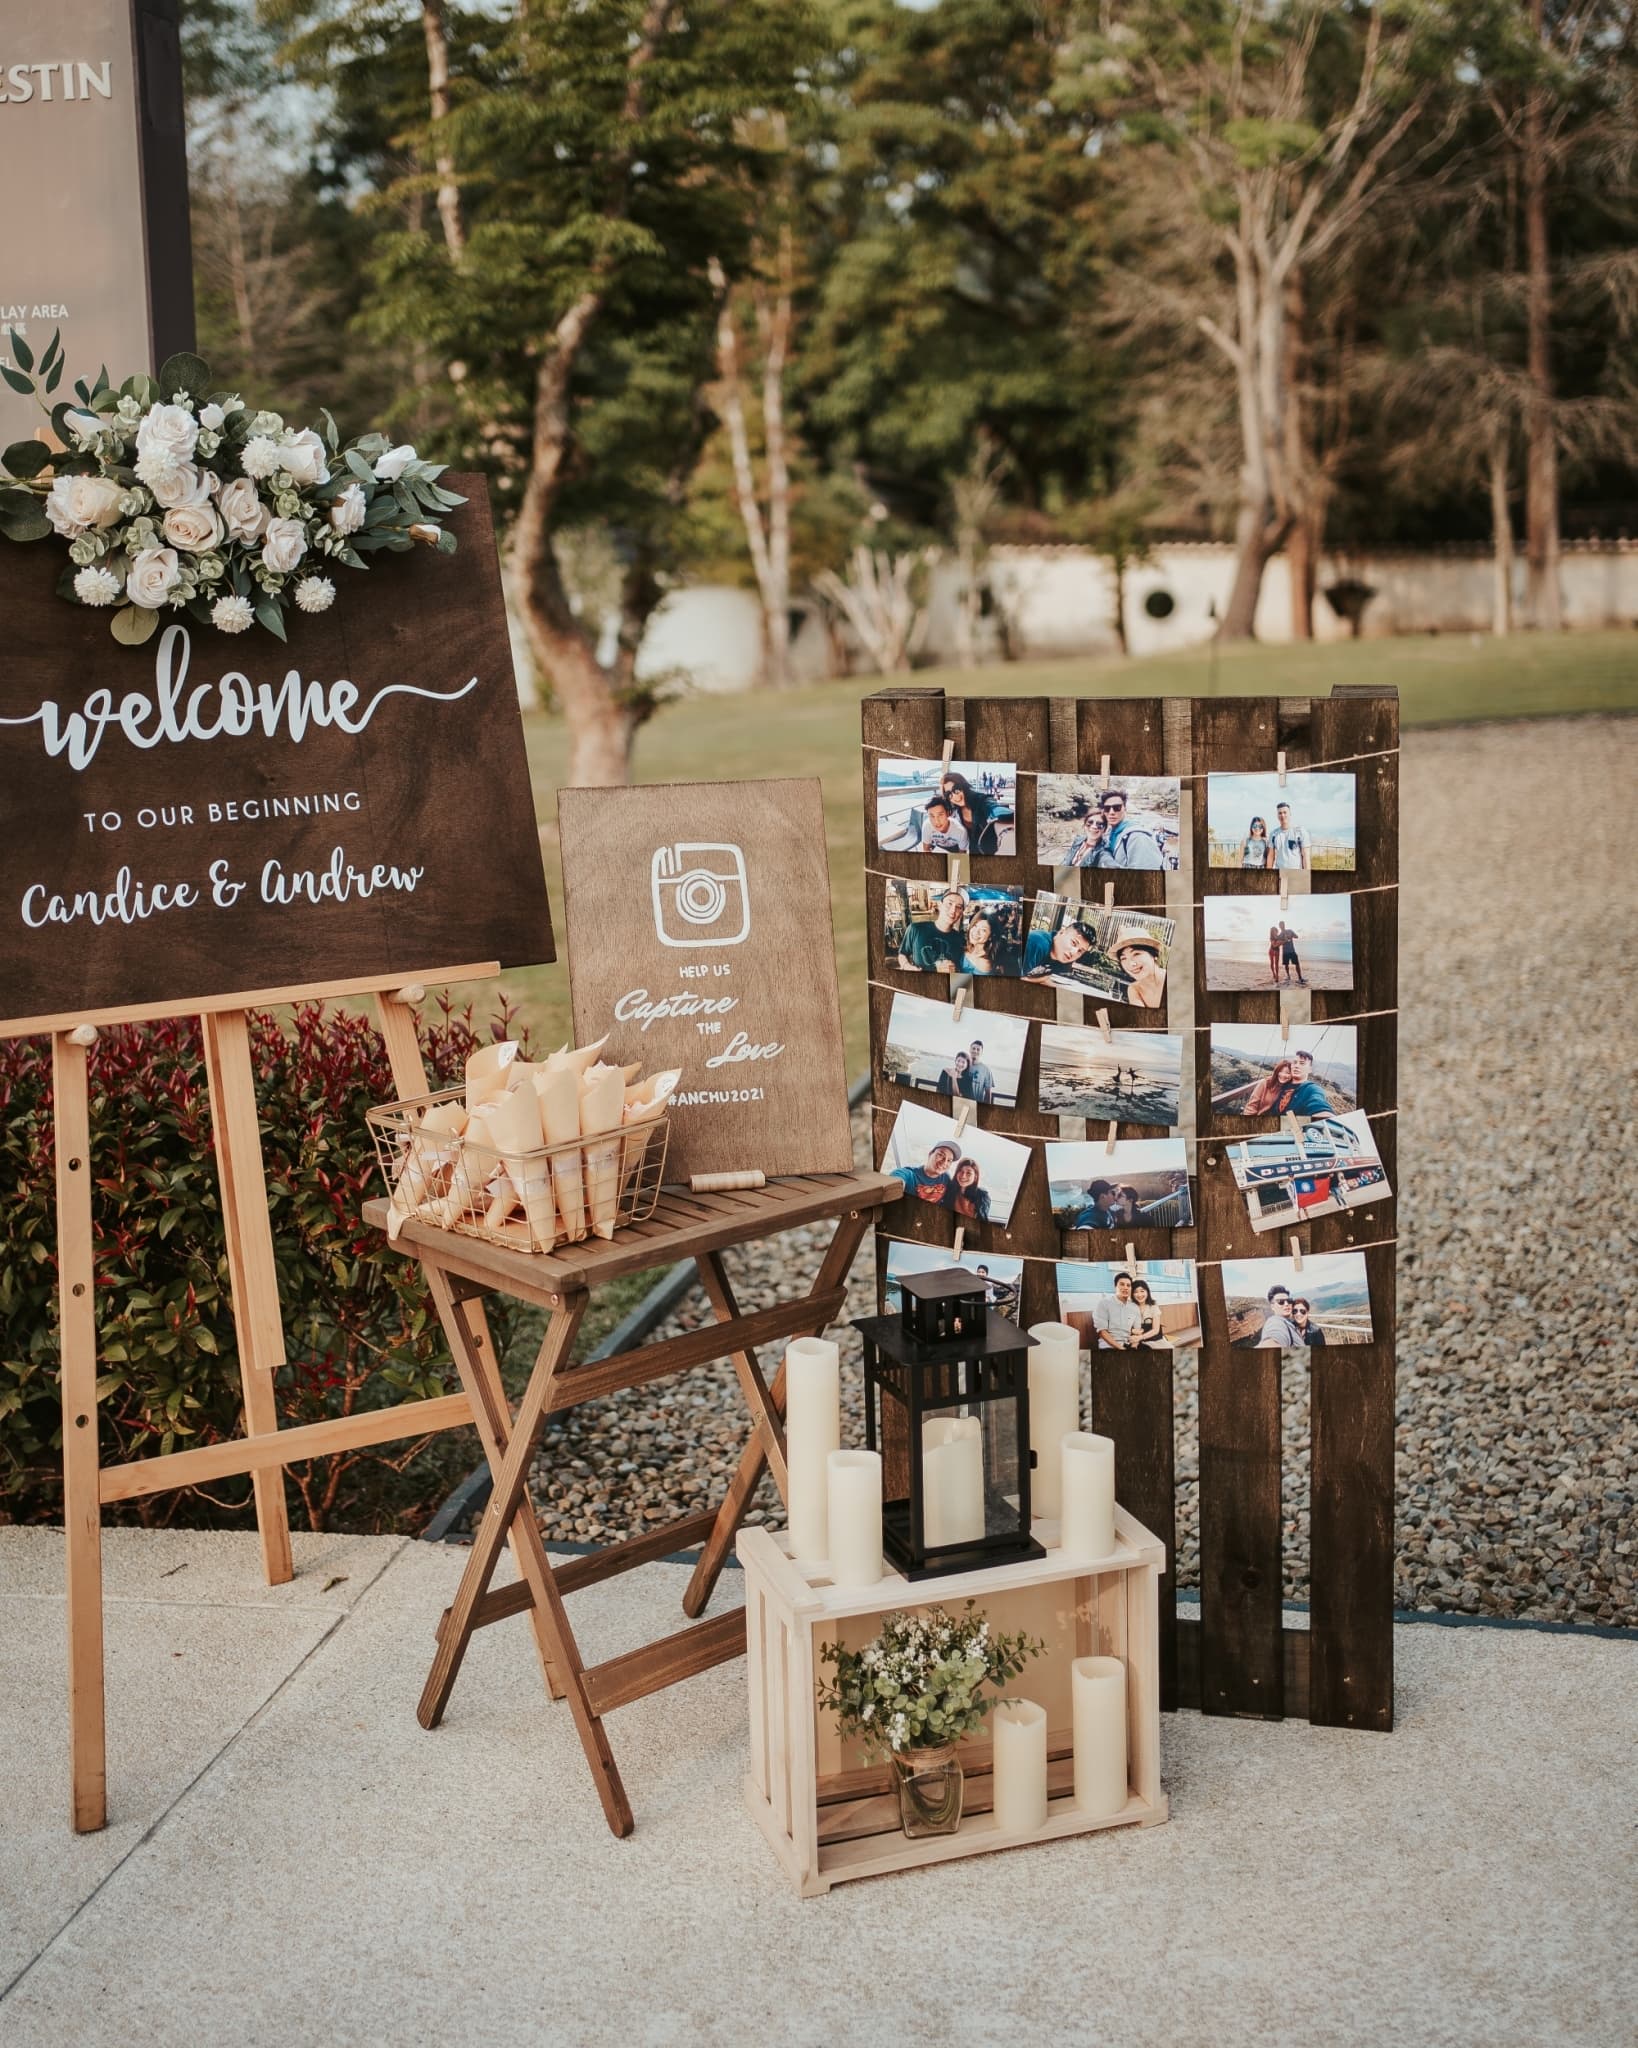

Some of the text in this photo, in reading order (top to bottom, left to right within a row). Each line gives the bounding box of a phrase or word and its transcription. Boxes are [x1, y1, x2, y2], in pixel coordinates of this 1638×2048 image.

[31, 304, 69, 318] AREA
[0, 624, 478, 771] welcome
[83, 791, 361, 833] TO OUR BEGINNING
[21, 846, 424, 928] Candice & Andrew
[679, 964, 731, 978] HELP US
[614, 989, 740, 1031] Capture
[696, 1021, 721, 1035] THE
[705, 1031, 786, 1069] Love
[668, 1087, 764, 1106] #ANCHU2021
